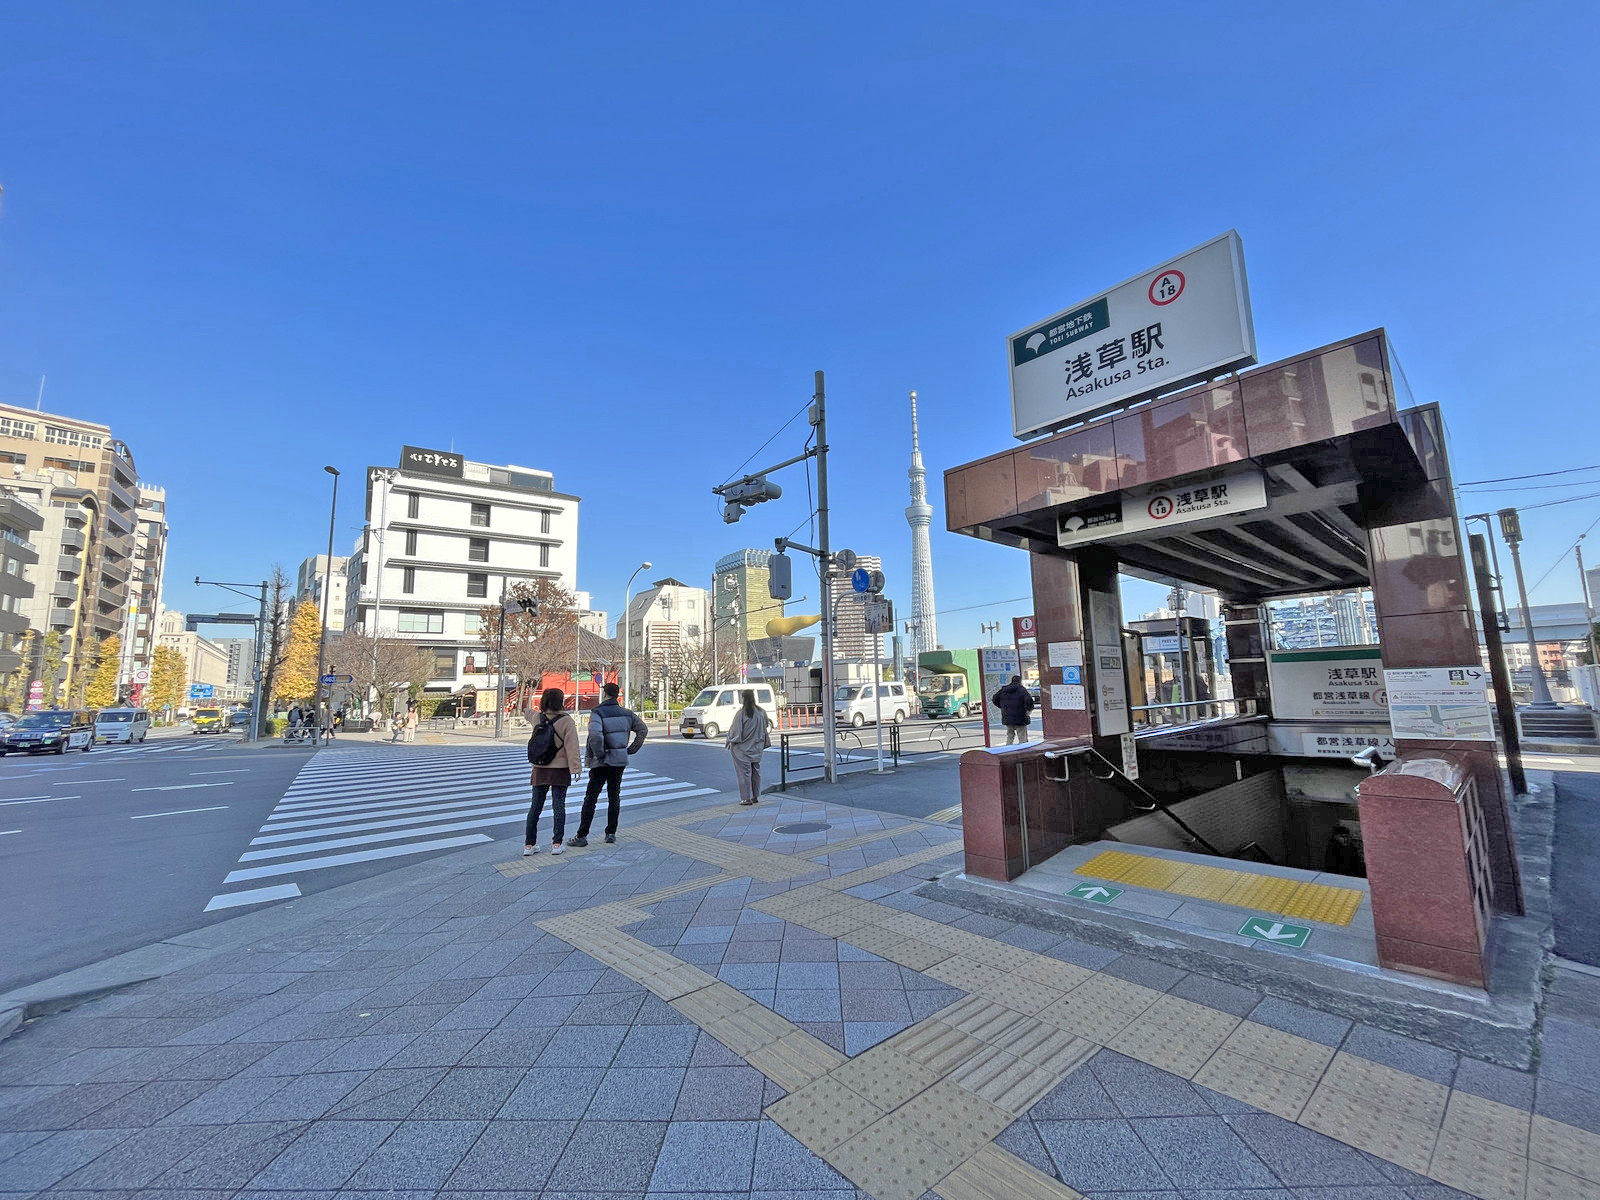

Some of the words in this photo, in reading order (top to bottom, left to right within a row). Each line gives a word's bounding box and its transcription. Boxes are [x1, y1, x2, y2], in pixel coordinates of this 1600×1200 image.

[1161, 277, 1172, 288] A
[1159, 285, 1177, 300] 18
[1048, 312, 1094, 337] 都営地下鉄
[1049, 335, 1065, 346] TOEI
[1065, 321, 1094, 341] SUBWAY
[1064, 322, 1165, 386] 浅草駅
[1065, 370, 1132, 401] Asakusa
[1137, 356, 1170, 376] Sta.
[1175, 484, 1228, 507] 浅草駅
[1155, 506, 1167, 515] 18
[1175, 502, 1212, 515] Asakusa
[1214, 498, 1231, 508] Sta.
[1327, 667, 1377, 680] 浅草駅
[1312, 691, 1371, 701] 都営浅草線
